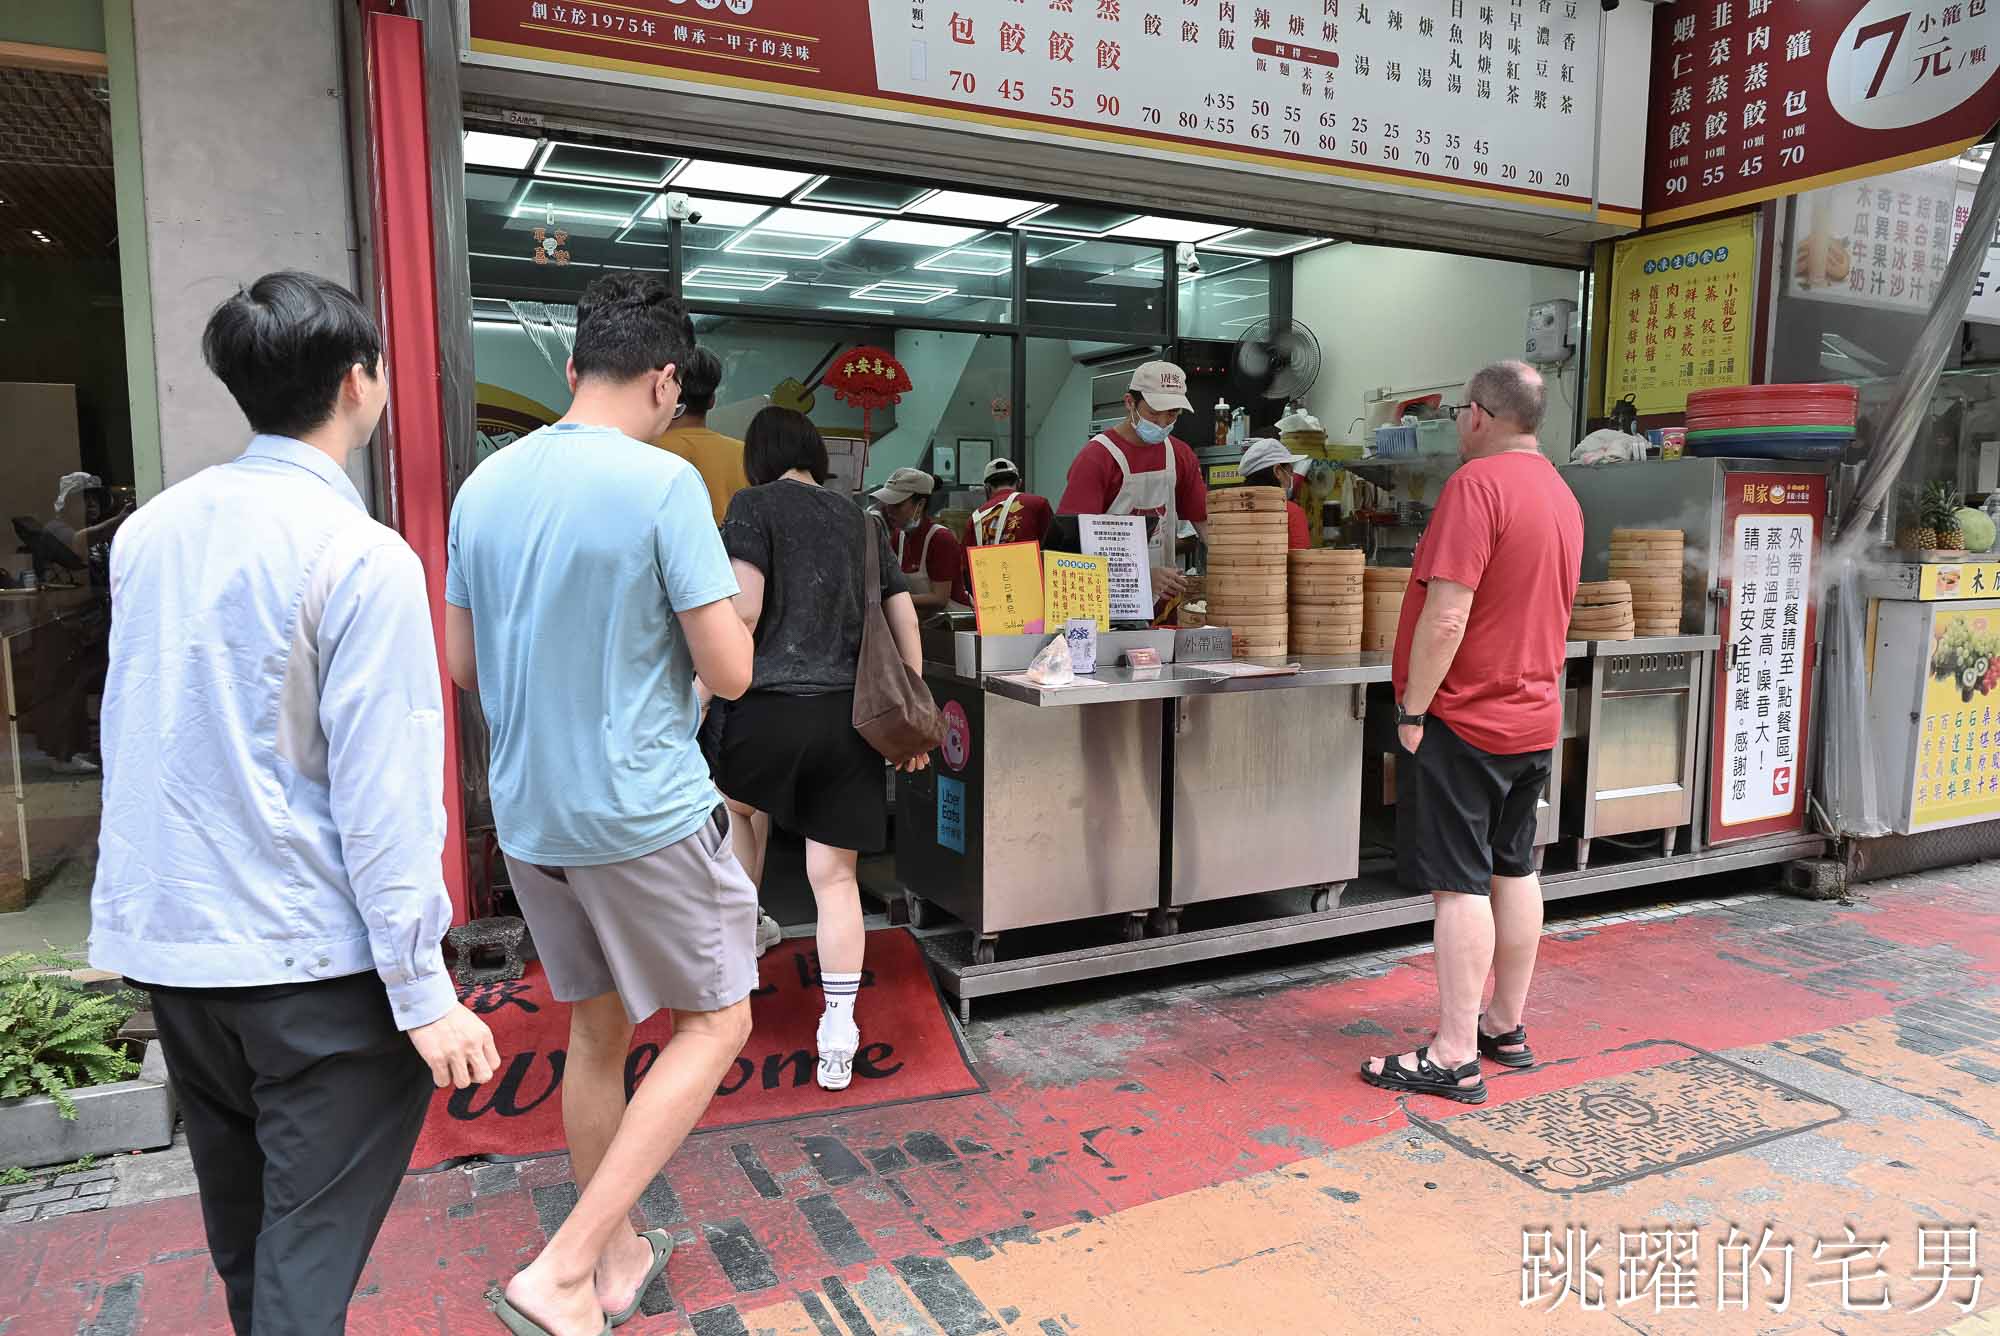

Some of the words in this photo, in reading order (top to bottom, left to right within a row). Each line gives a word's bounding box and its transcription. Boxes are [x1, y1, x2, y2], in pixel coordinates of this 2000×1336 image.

[532, 1, 657, 37] 創立於1975年
[672, 24, 811, 61] 傳承一甲子的美味
[948, 11, 976, 46] 包
[999, 0, 1026, 55] 餃
[1144, 13, 1162, 37] 餃
[1181, 0, 1199, 43] 餃
[1218, 0, 1236, 50] 肉飯
[1254, 8, 1270, 30] 辣
[1669, 14, 1697, 150] 蝦仁蒸餃
[1704, 1, 1733, 140] 韭菜蒸餃
[1853, 11, 1911, 100] 7
[949, 70, 976, 94] 70
[998, 79, 1025, 102] 45
[1050, 87, 1074, 109] 55
[1096, 94, 1120, 117] 90
[1142, 107, 1161, 124] 70
[1179, 111, 1198, 129] 80
[1251, 100, 1270, 117] 50
[1284, 105, 1301, 123] 55
[1319, 111, 1336, 128] 65
[1351, 117, 1368, 133] 25
[1384, 123, 1399, 139] 25
[1415, 130, 1431, 145] 35
[1445, 134, 1460, 149] 35
[1474, 140, 1489, 155] 45
[1743, 135, 1765, 150] 10顆
[1782, 124, 1806, 139] 10顆
[1250, 123, 1270, 140] 65
[1283, 129, 1300, 146] 70
[1319, 134, 1336, 151] 80
[1350, 139, 1368, 156] 50
[1383, 145, 1399, 161] 50
[1415, 151, 1430, 166] 70
[1444, 155, 1460, 171] 70
[1473, 161, 1488, 176] 90
[1502, 164, 1517, 180] 20
[1529, 170, 1543, 185] 20
[1555, 172, 1570, 187] 20
[1665, 175, 1688, 196] 90
[1702, 165, 1725, 187] 55
[1739, 157, 1763, 177] 45
[1780, 145, 1805, 168] 70
[1743, 484, 1768, 504] 周家
